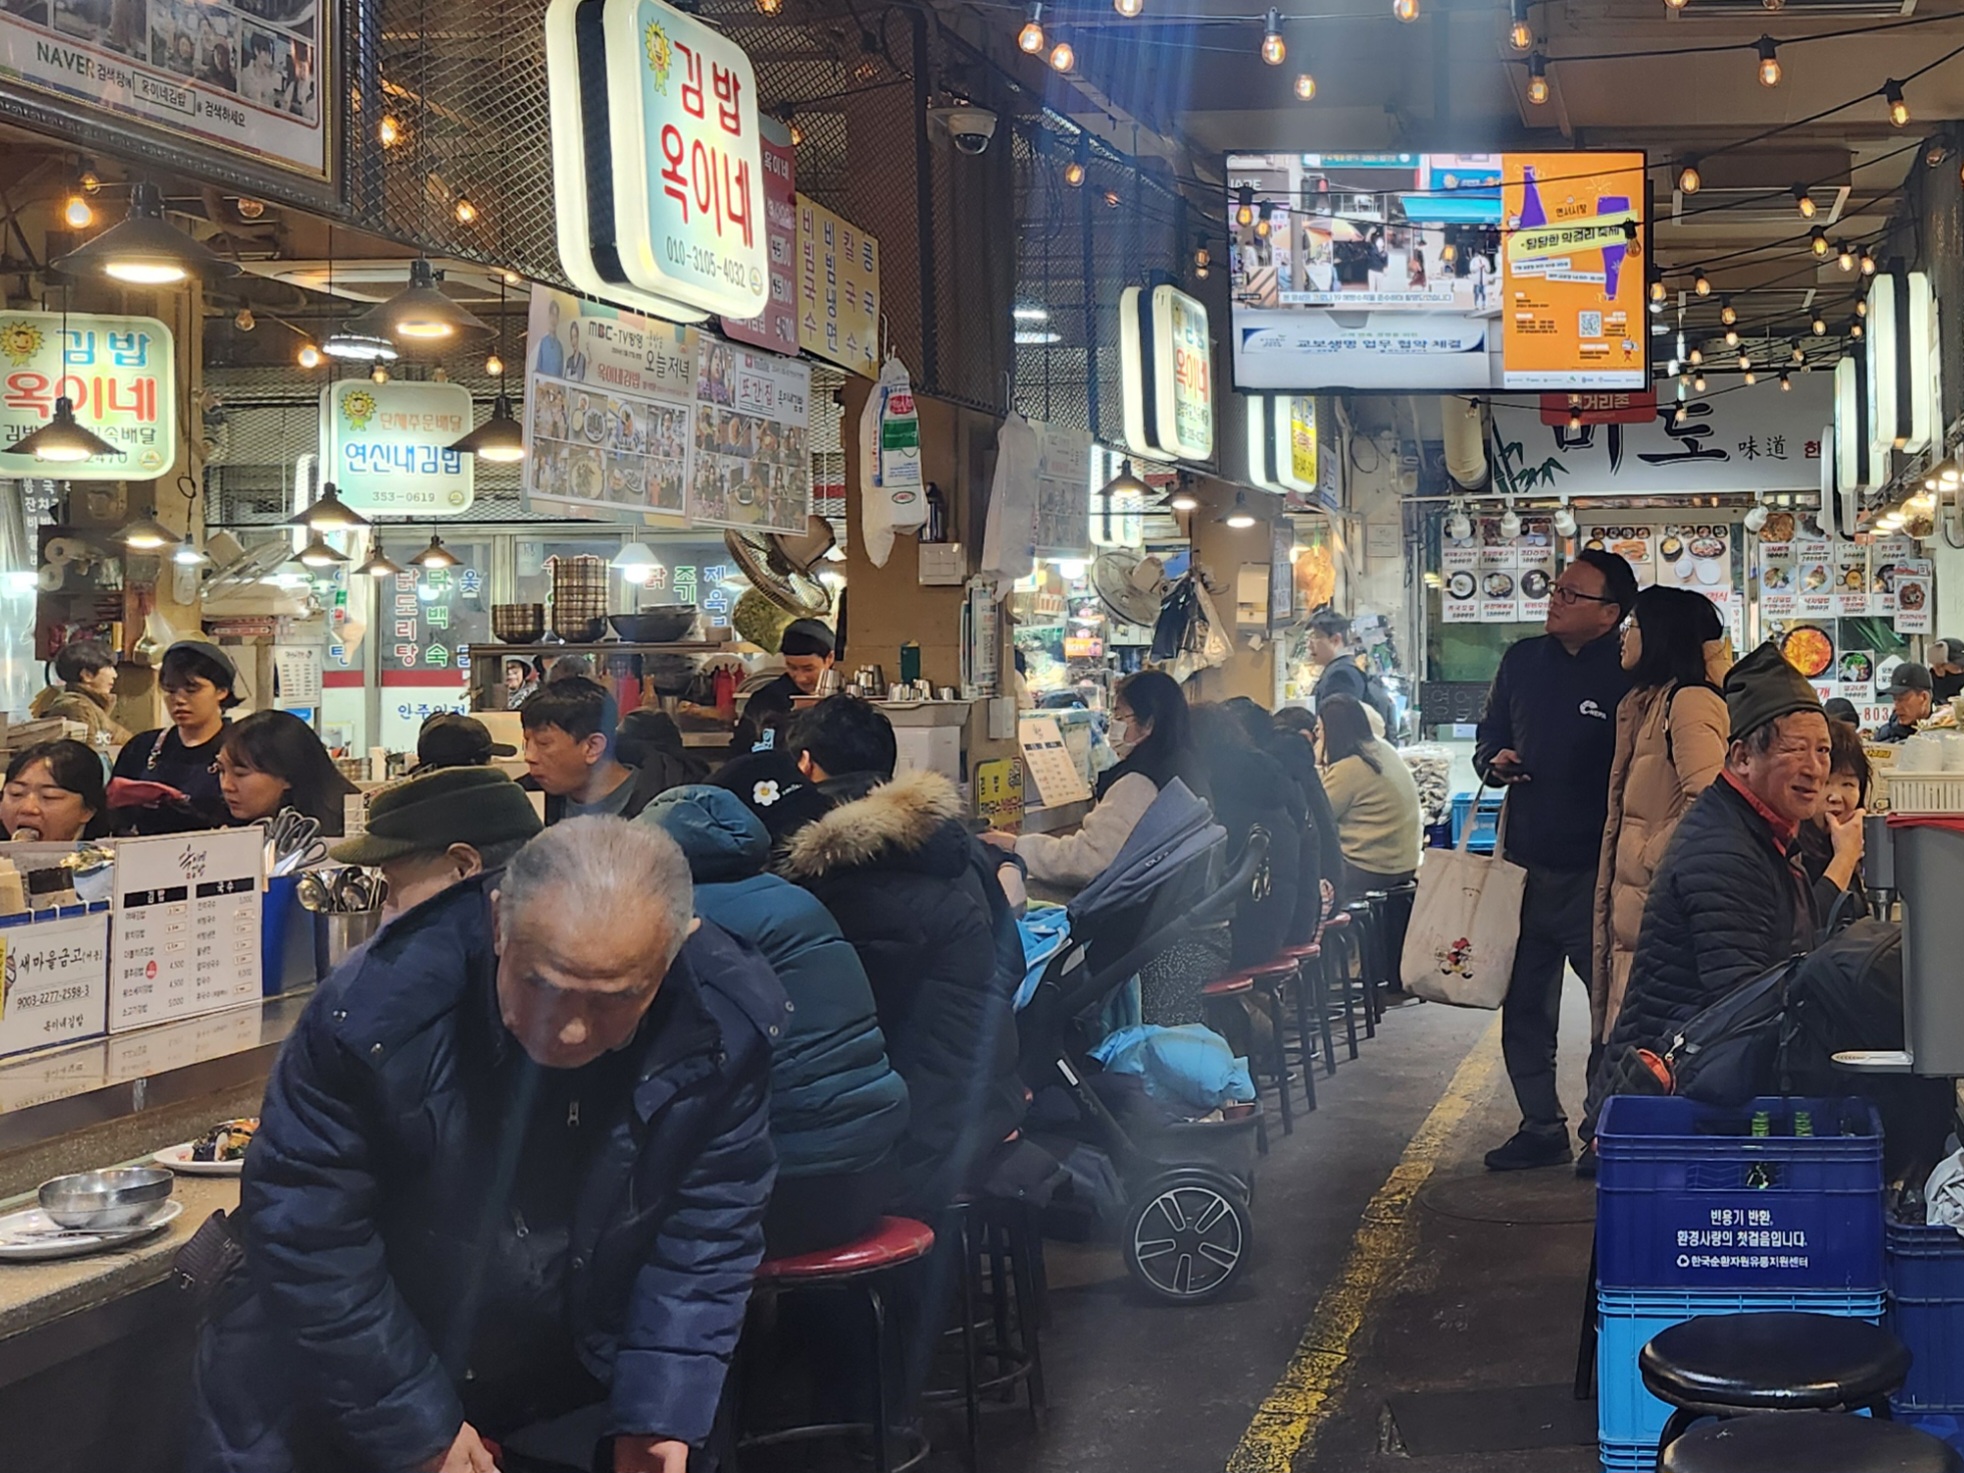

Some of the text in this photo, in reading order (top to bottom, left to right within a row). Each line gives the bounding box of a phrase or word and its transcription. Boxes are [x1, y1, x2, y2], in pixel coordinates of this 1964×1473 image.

[36, 41, 95, 79] NAVER
[204, 100, 246, 127] 검색하세요
[674, 40, 740, 137] 김밥
[661, 123, 753, 249] 옥이네
[666, 235, 746, 288] 010-3105-4032
[803, 208, 817, 342] 비빔국수
[824, 221, 838, 352] 비빔냉면
[843, 230, 857, 361] 칼국수
[56, 328, 150, 367] 김밥
[1296, 339, 1357, 349] 교보생명
[1362, 339, 1391, 349] 업무
[1398, 339, 1427, 349] 협약
[1431, 339, 1461, 349] 체결
[4, 374, 156, 422] 옥이네
[379, 412, 462, 433] 단체주문배달
[344, 442, 463, 474] 연신내김밥
[1737, 435, 1788, 461] 味道
[372, 491, 436, 503] 353-0619
[395, 569, 420, 668] 닭도리탕
[425, 569, 450, 667] 닭백숙
[217, 880, 234, 894] 국수
[1677, 1230, 1807, 1247] 환경사랑의 첫걸음입니다.
[1711, 1209, 1744, 1226] 빈용기
[1691, 1255, 1808, 1268] 한국순환자원유통지원센터
